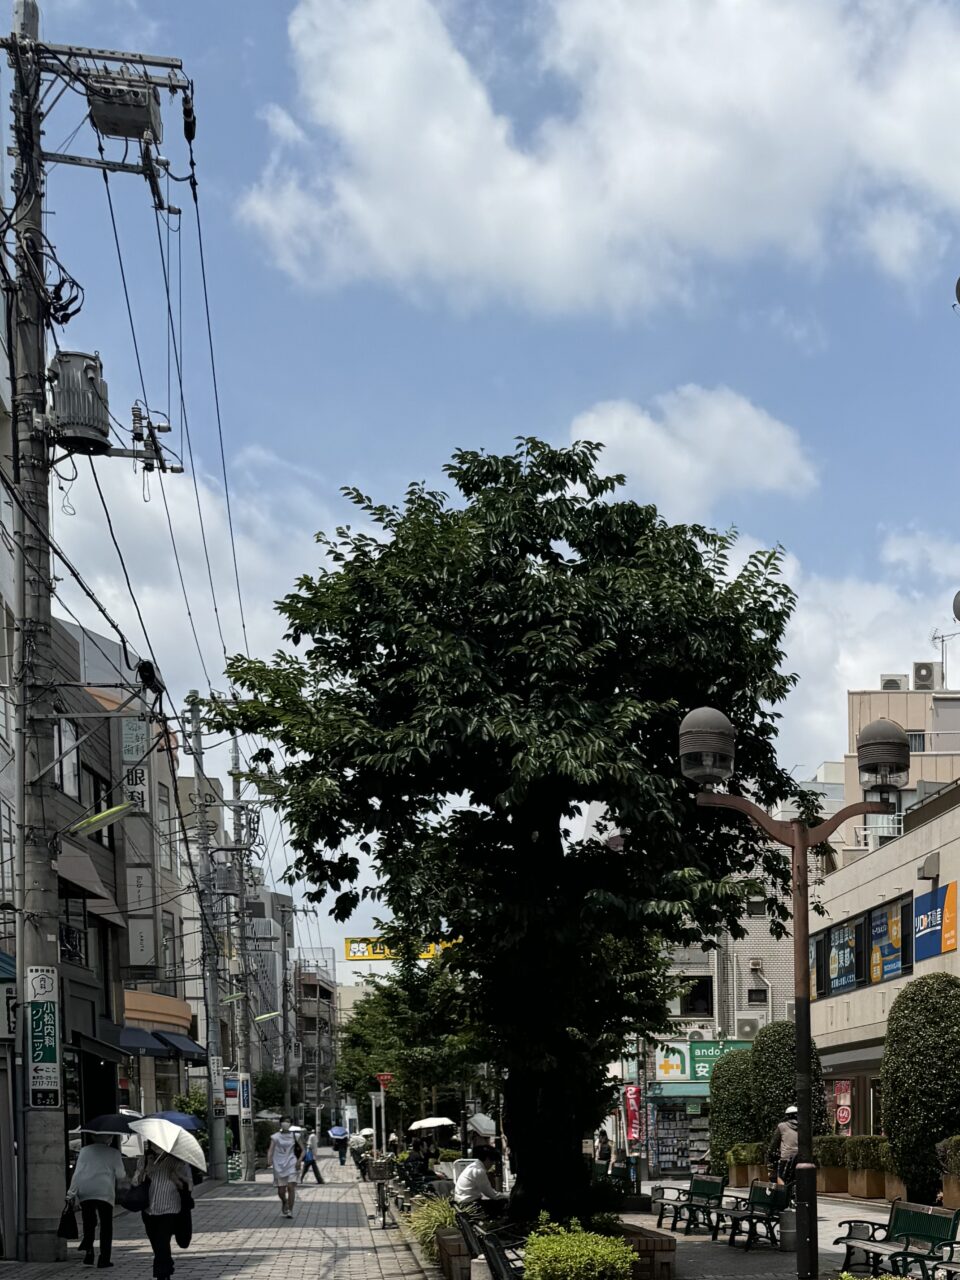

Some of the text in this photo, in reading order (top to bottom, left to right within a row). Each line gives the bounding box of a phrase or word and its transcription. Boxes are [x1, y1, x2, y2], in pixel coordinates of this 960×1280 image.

[126, 767, 146, 809] 眼科
[32, 1008, 44, 1062] クリニック
[43, 1001, 55, 1048] 小松内科
[695, 1047, 720, 1056] ando
[695, 1063, 709, 1077] 安
